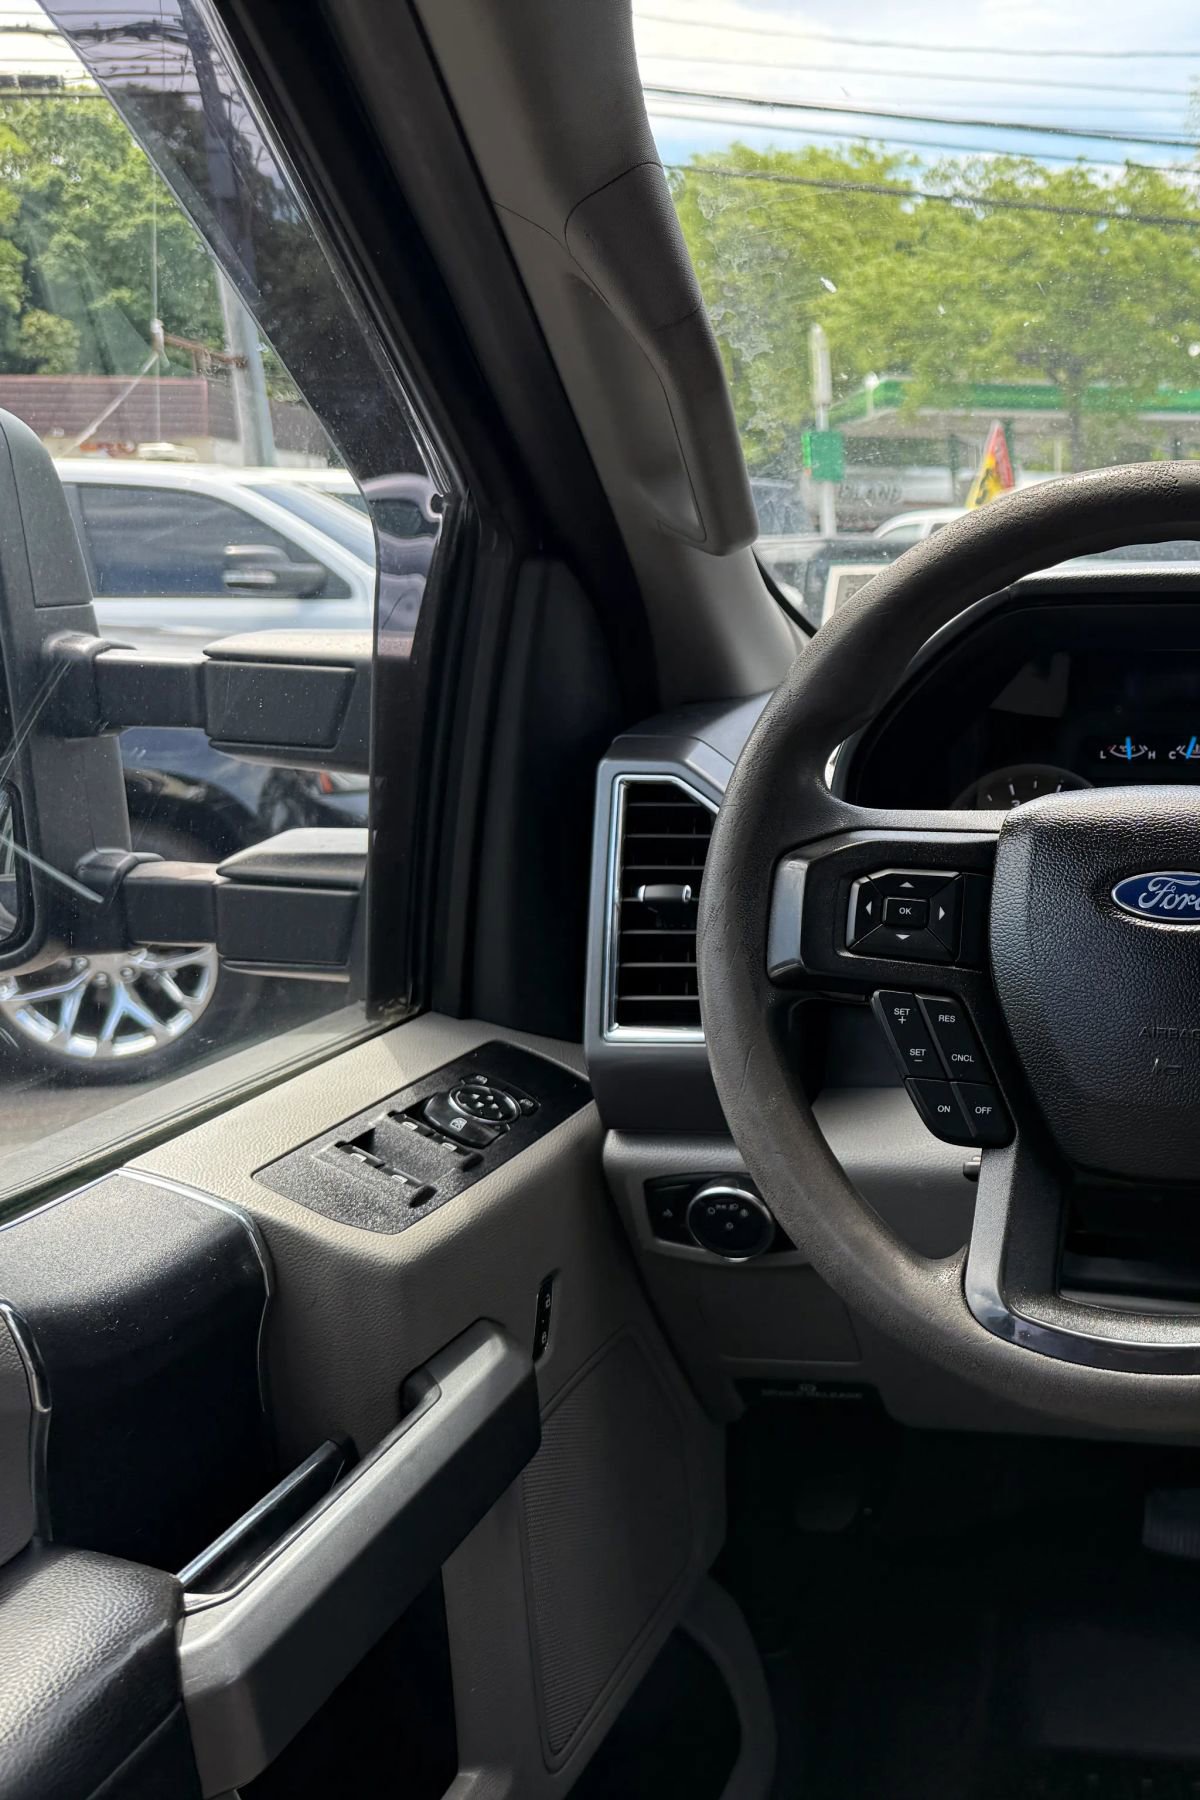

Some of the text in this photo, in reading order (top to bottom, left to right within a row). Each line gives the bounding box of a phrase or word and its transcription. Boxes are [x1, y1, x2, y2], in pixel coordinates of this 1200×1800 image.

[1100, 751, 1156, 759] L H
[1169, 751, 1176, 759] C
[899, 907, 912, 915] OK
[894, 1008, 910, 1016] SET
[938, 1015, 956, 1023] RES
[909, 1049, 926, 1057] SET
[952, 1054, 975, 1063] CNCL
[937, 1105, 950, 1113] ON
[975, 1107, 992, 1115] OFF
